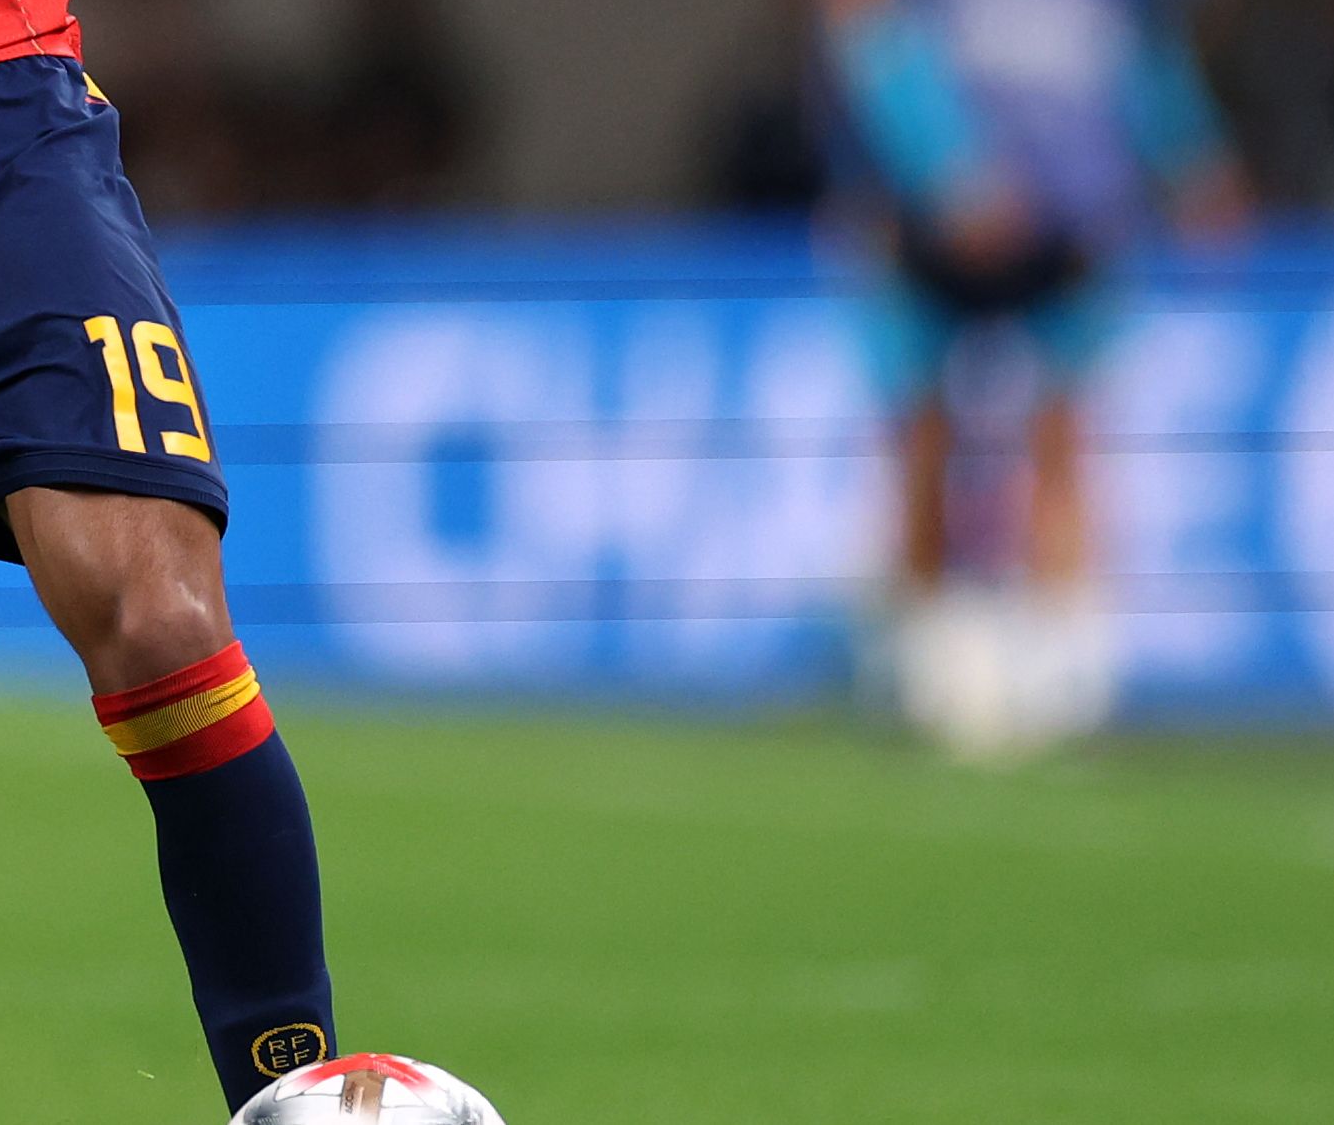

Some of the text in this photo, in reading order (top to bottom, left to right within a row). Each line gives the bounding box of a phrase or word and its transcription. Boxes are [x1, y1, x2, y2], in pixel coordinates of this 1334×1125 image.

[83, 315, 211, 464] 19
[268, 1033, 308, 1054] RF
[272, 1048, 310, 1069] EF
